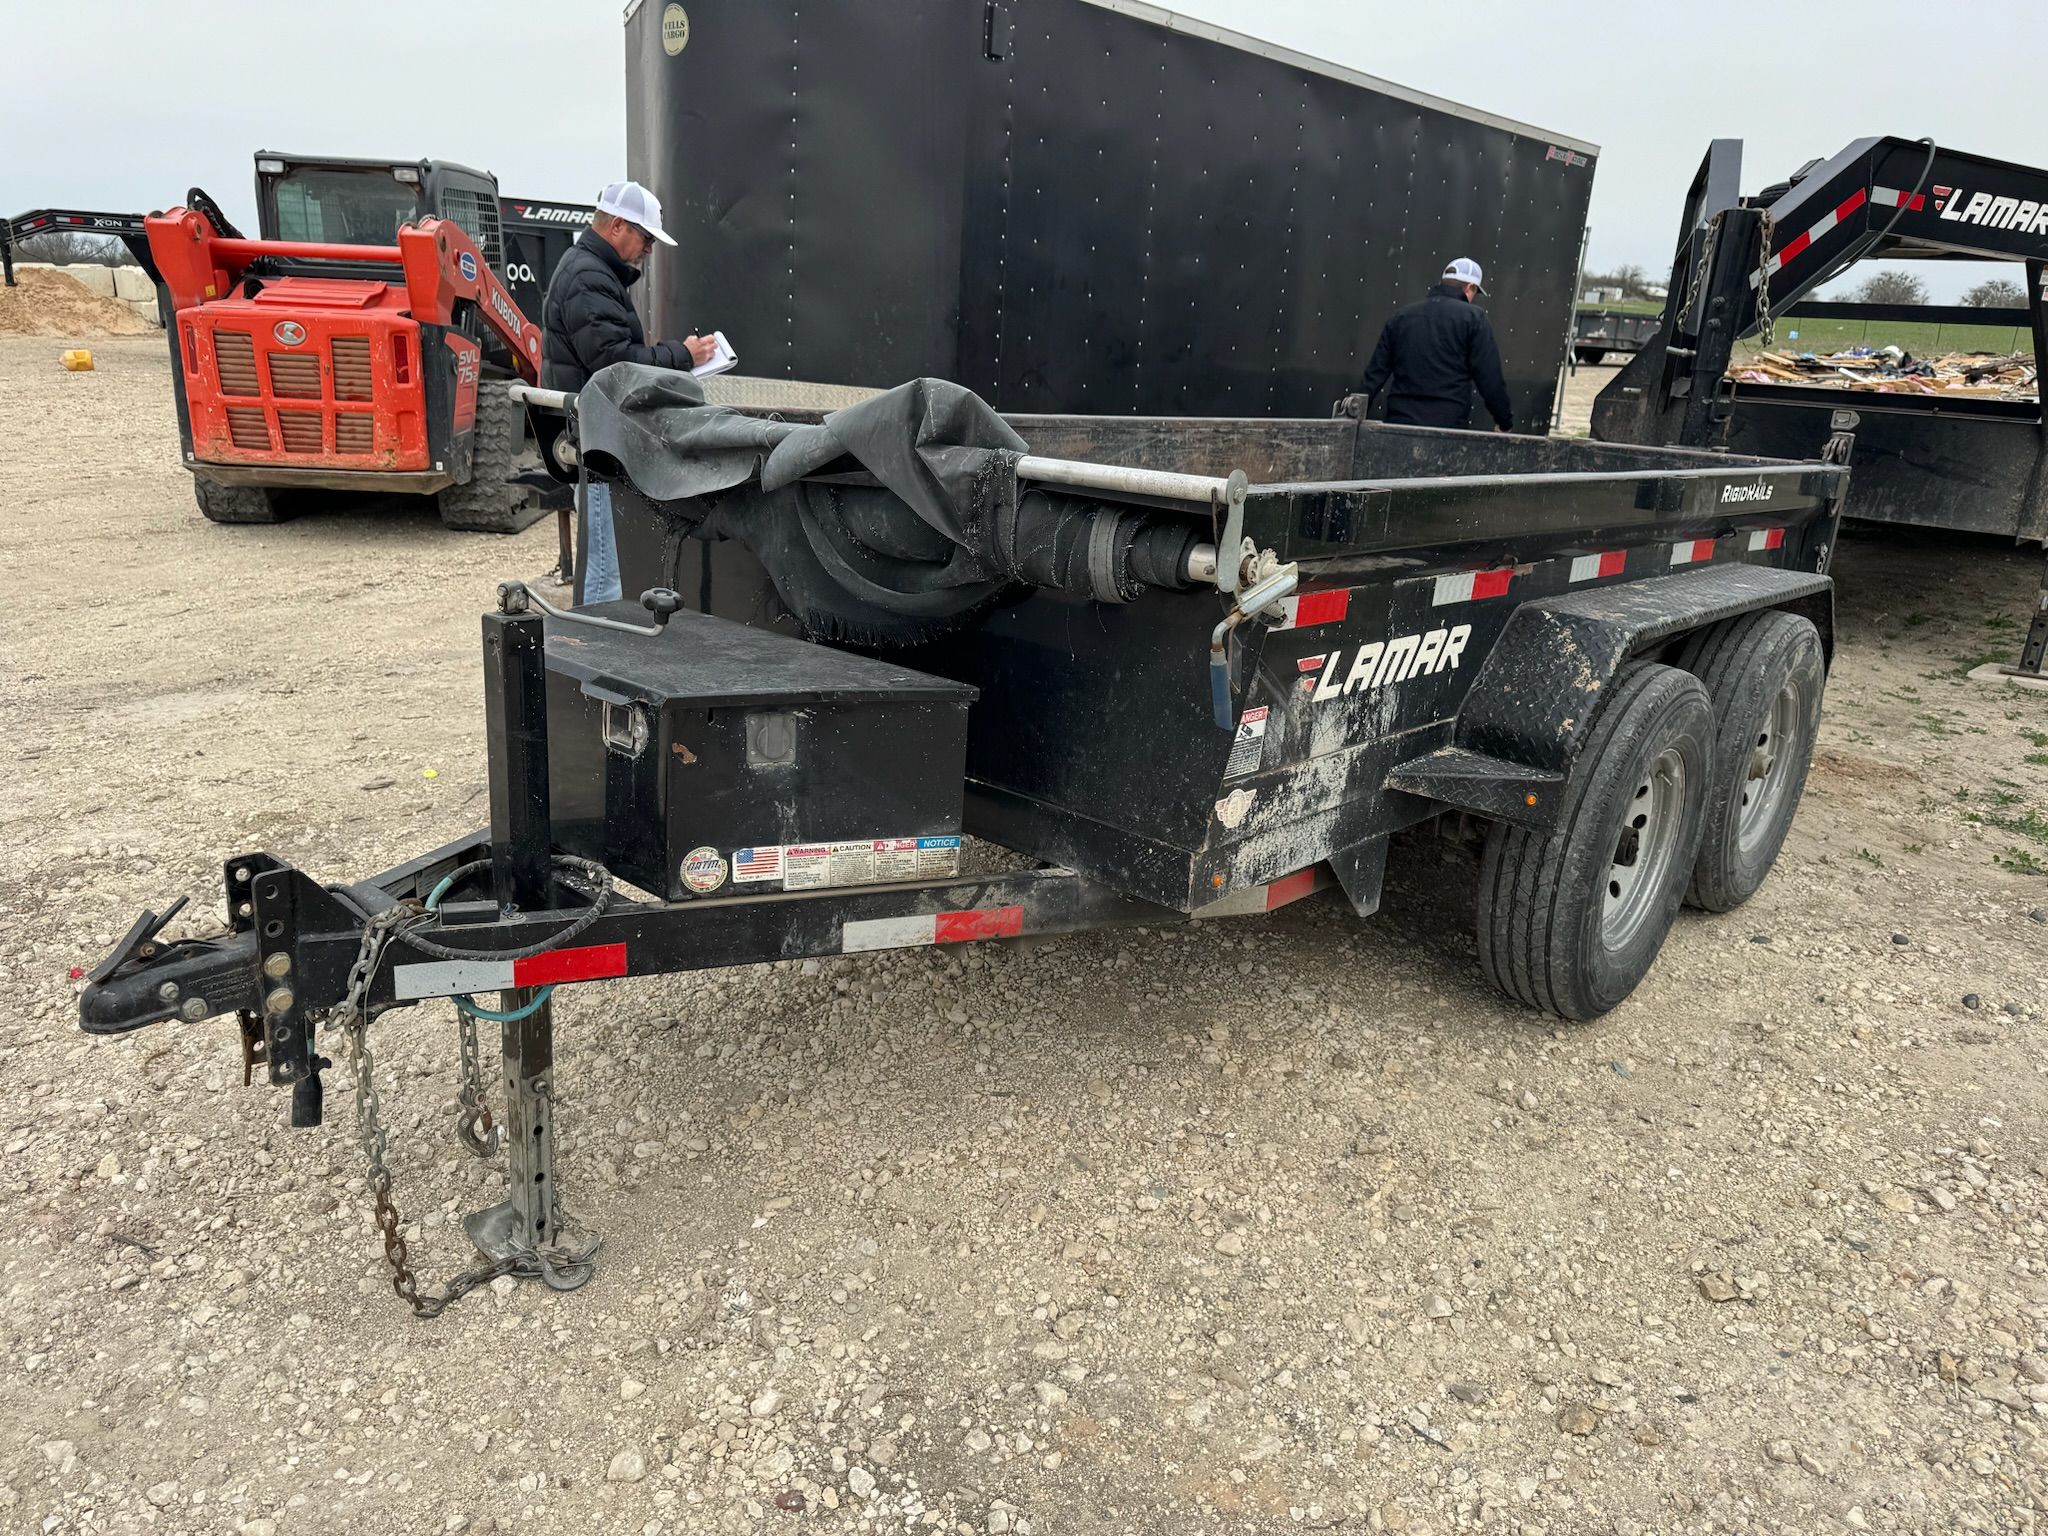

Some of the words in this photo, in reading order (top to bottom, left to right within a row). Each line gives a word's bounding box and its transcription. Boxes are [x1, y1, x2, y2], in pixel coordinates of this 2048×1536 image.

[664, 30, 685, 40] CARGO
[522, 206, 595, 224] LAMAR
[1940, 188, 2048, 236] LAMAR
[491, 287, 522, 338] KUBOTA
[458, 350, 479, 366] SVL
[1311, 623, 1472, 703] LAMAR
[839, 844, 872, 853] CAUTION
[923, 839, 955, 848] NOTICE
